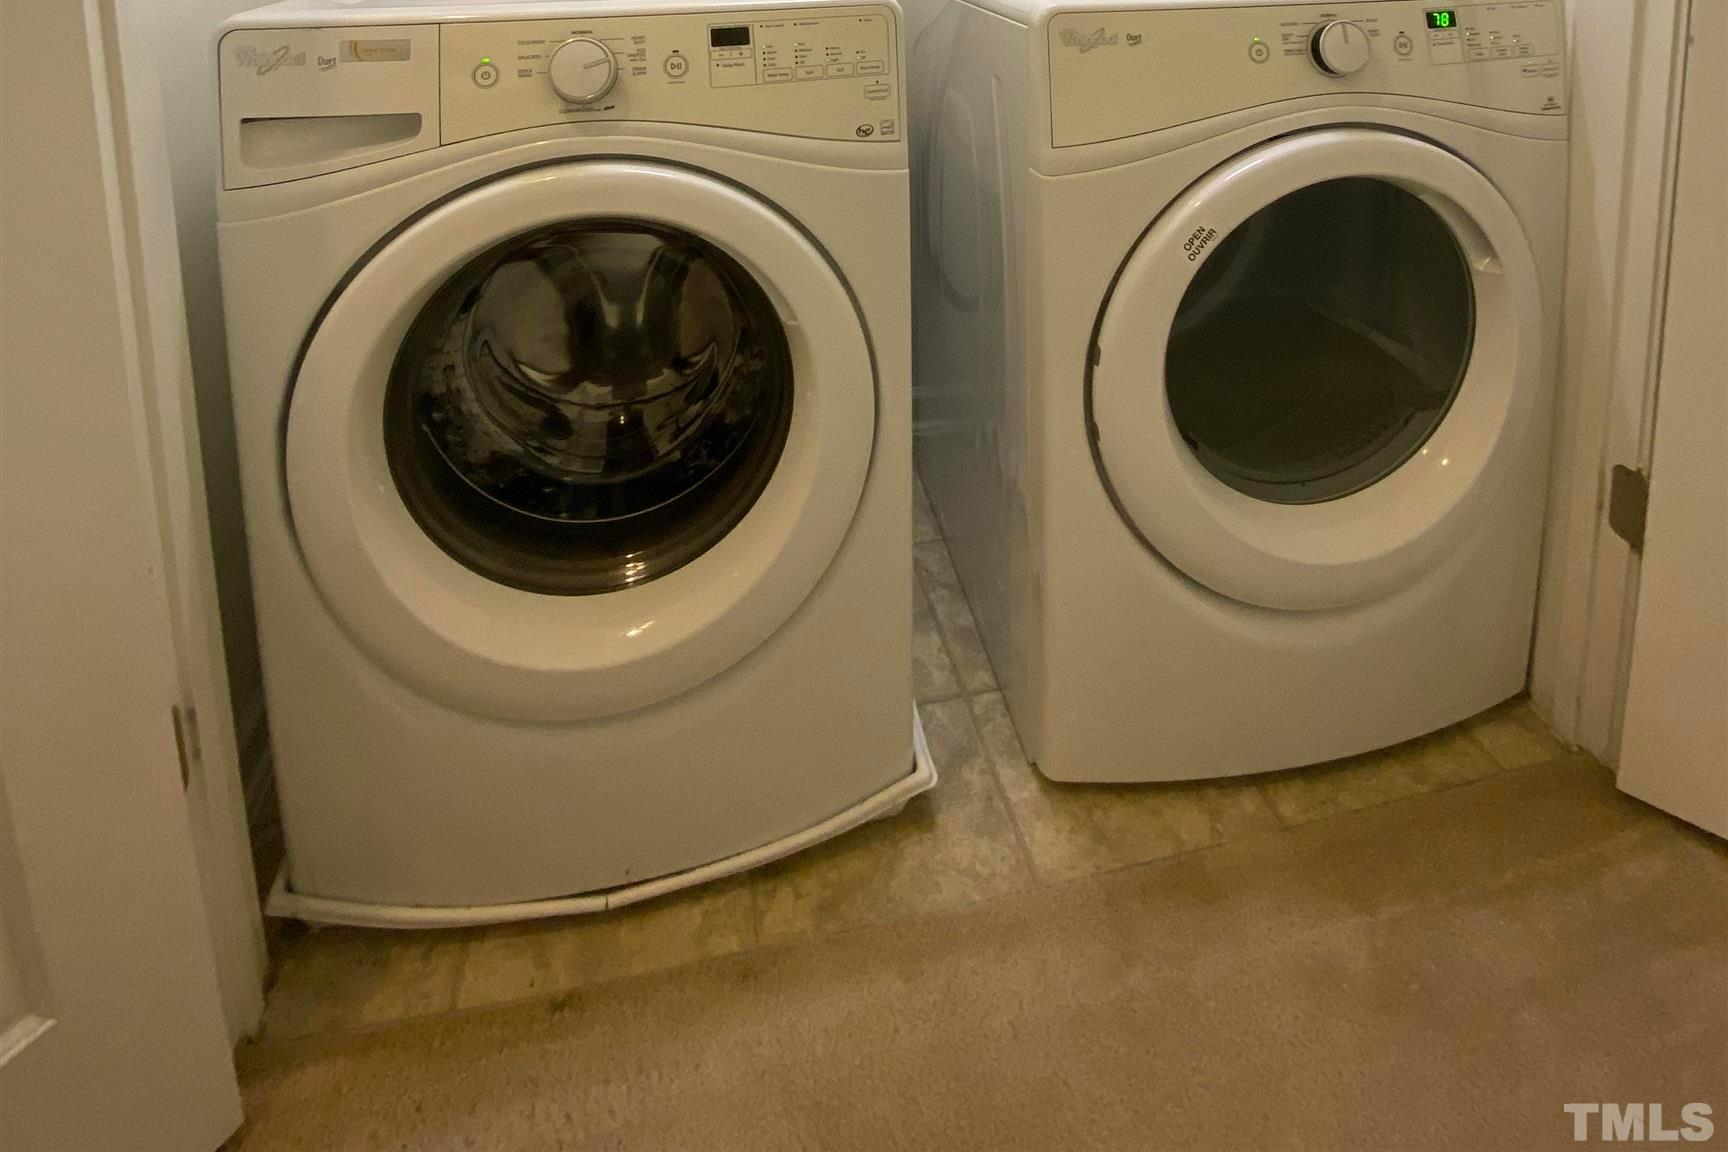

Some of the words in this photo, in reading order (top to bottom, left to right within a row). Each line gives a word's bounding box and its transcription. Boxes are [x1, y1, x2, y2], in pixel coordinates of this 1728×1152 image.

[1433, 13, 1450, 27] 78
[1183, 226, 1206, 251] OPEN
[1187, 228, 1217, 262] OUVRIR
